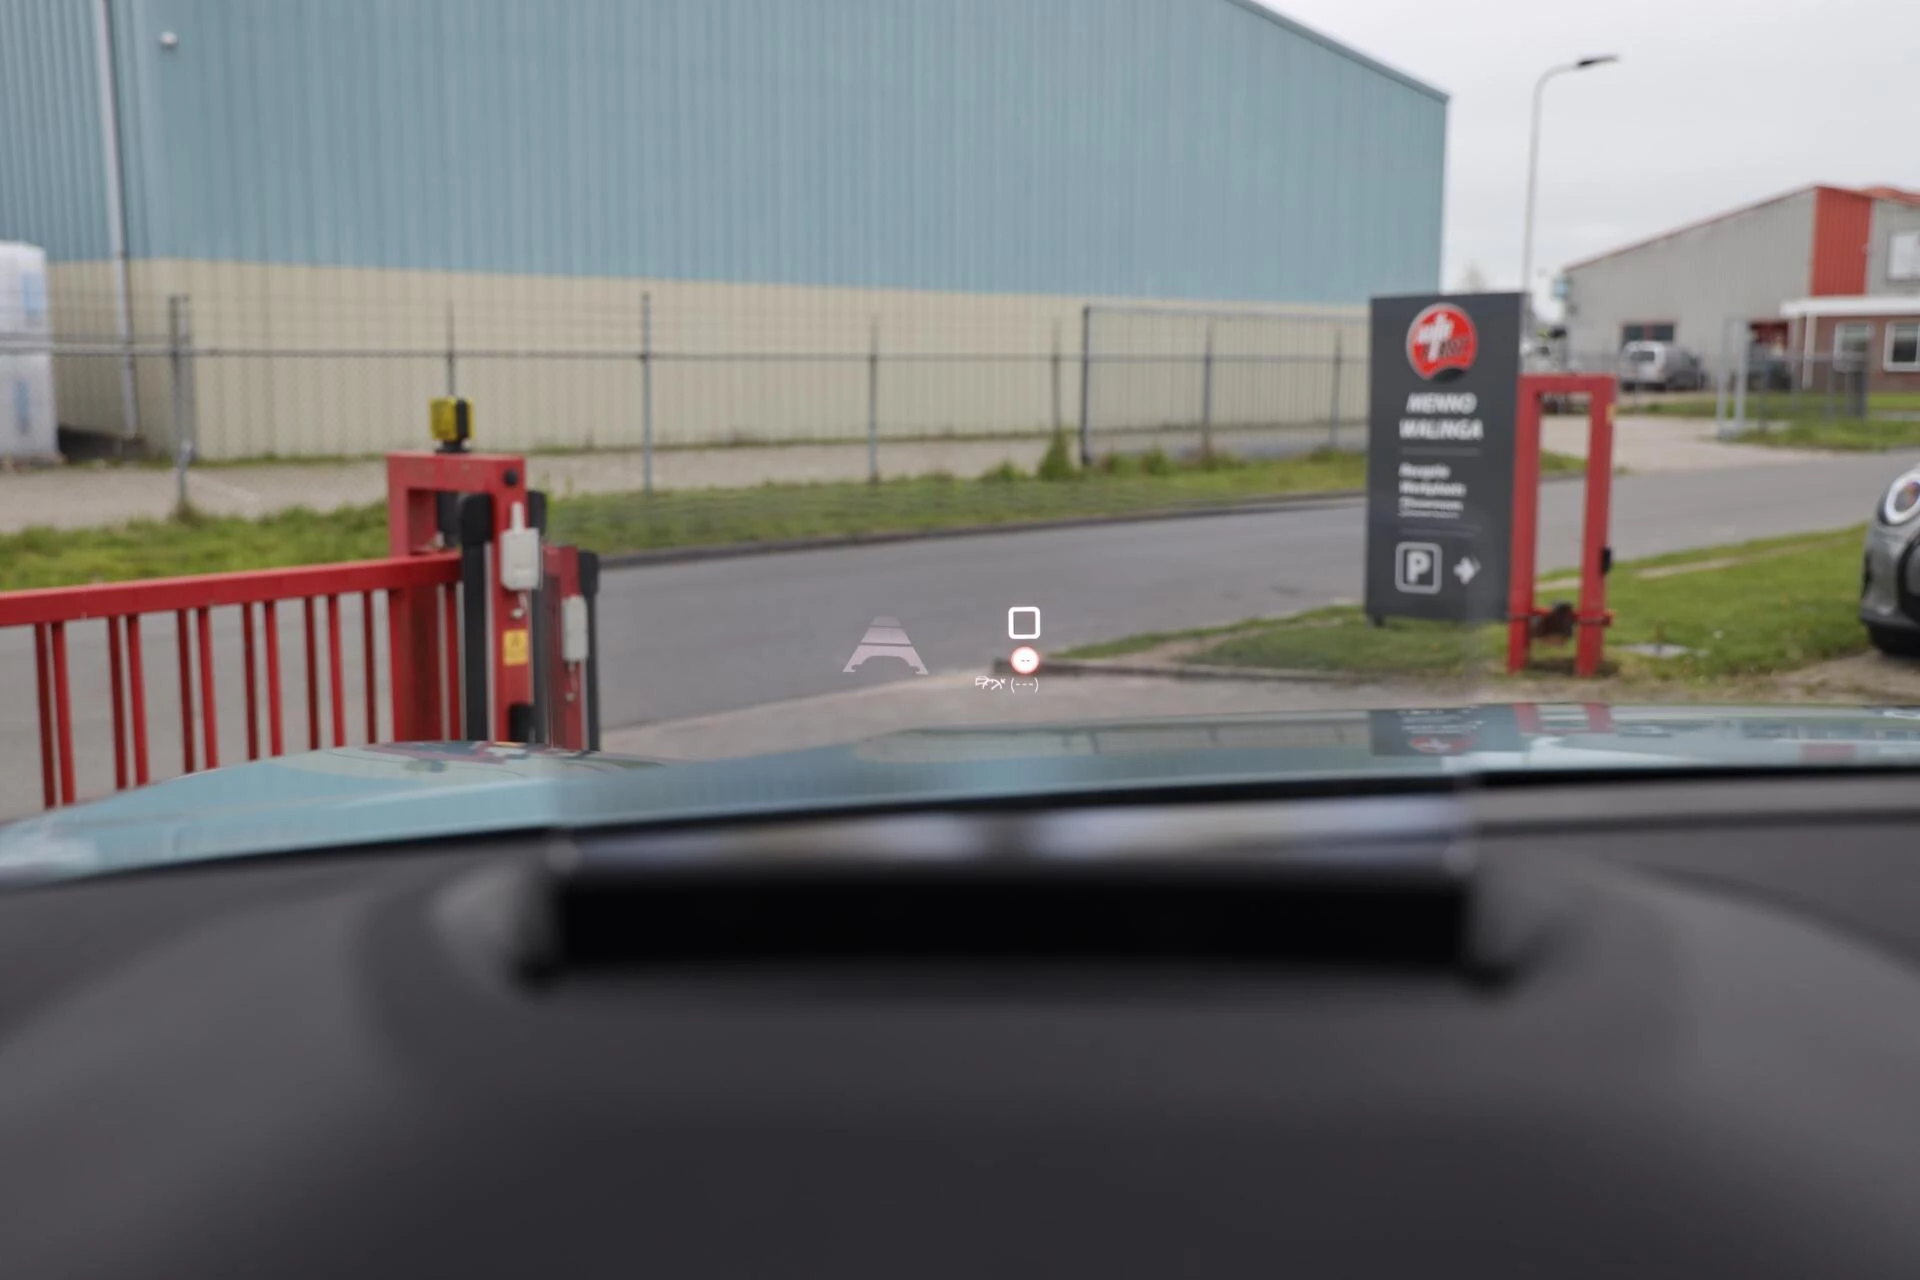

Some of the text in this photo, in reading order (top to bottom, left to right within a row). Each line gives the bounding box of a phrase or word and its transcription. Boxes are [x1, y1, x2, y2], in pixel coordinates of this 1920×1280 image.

[1406, 392, 1477, 414] MENNO
[1399, 417, 1483, 440] MALINGA
[1407, 550, 1431, 584] P
